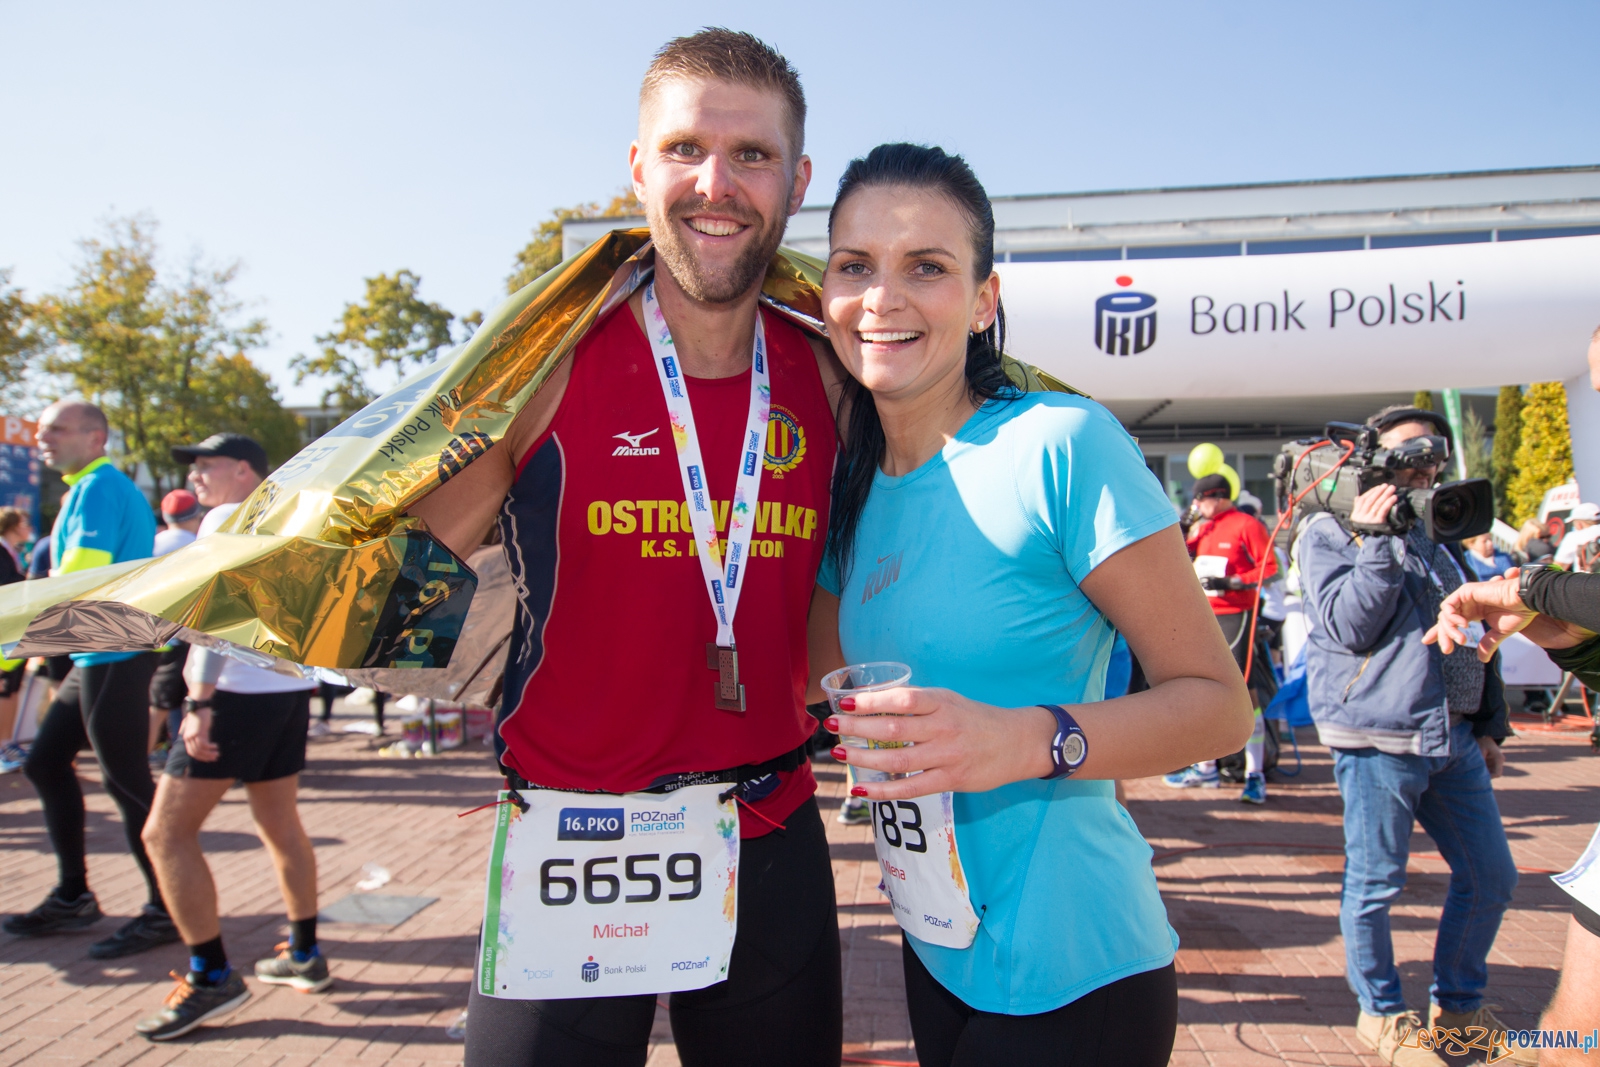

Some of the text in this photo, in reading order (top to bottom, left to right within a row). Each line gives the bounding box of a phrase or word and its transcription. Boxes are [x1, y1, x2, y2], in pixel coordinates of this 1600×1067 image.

[1191, 291, 1306, 335] Bank
[1330, 280, 1467, 329] Polski
[767, 412, 798, 434] RATON
[378, 416, 431, 462] Polski
[692, 475, 700, 488] PKO
[641, 539, 682, 558] K.S.
[861, 549, 904, 606] RUN
[664, 774, 720, 791] anti-shock
[564, 815, 619, 832] 16. PKO
[631, 821, 685, 832] maraton
[540, 852, 702, 906] 6659
[593, 922, 650, 939] Michał
[604, 965, 623, 975] Bank
[625, 964, 647, 974] Polski
